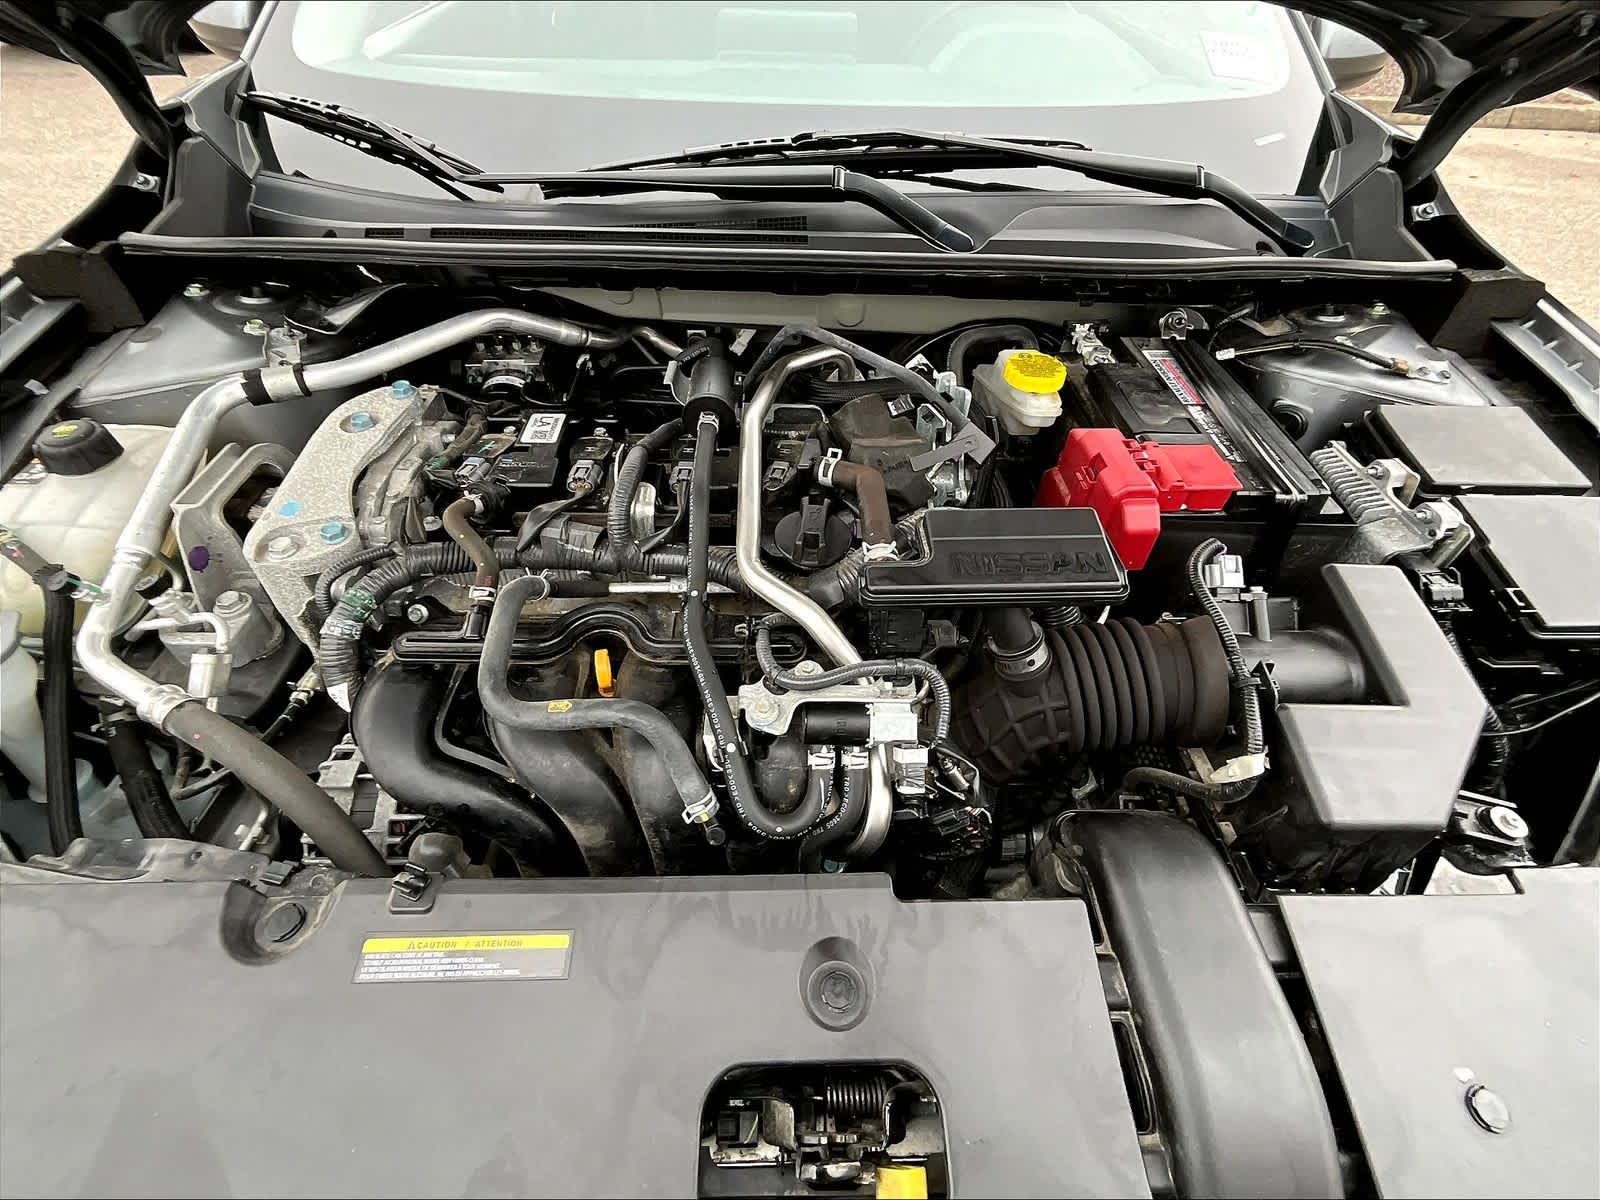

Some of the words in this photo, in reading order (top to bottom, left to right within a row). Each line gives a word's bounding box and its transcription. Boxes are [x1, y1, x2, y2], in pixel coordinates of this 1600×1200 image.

[952, 551, 1108, 576] NISSAN
[416, 941, 457, 949] CAUTION
[475, 939, 522, 948] ATTENTION
